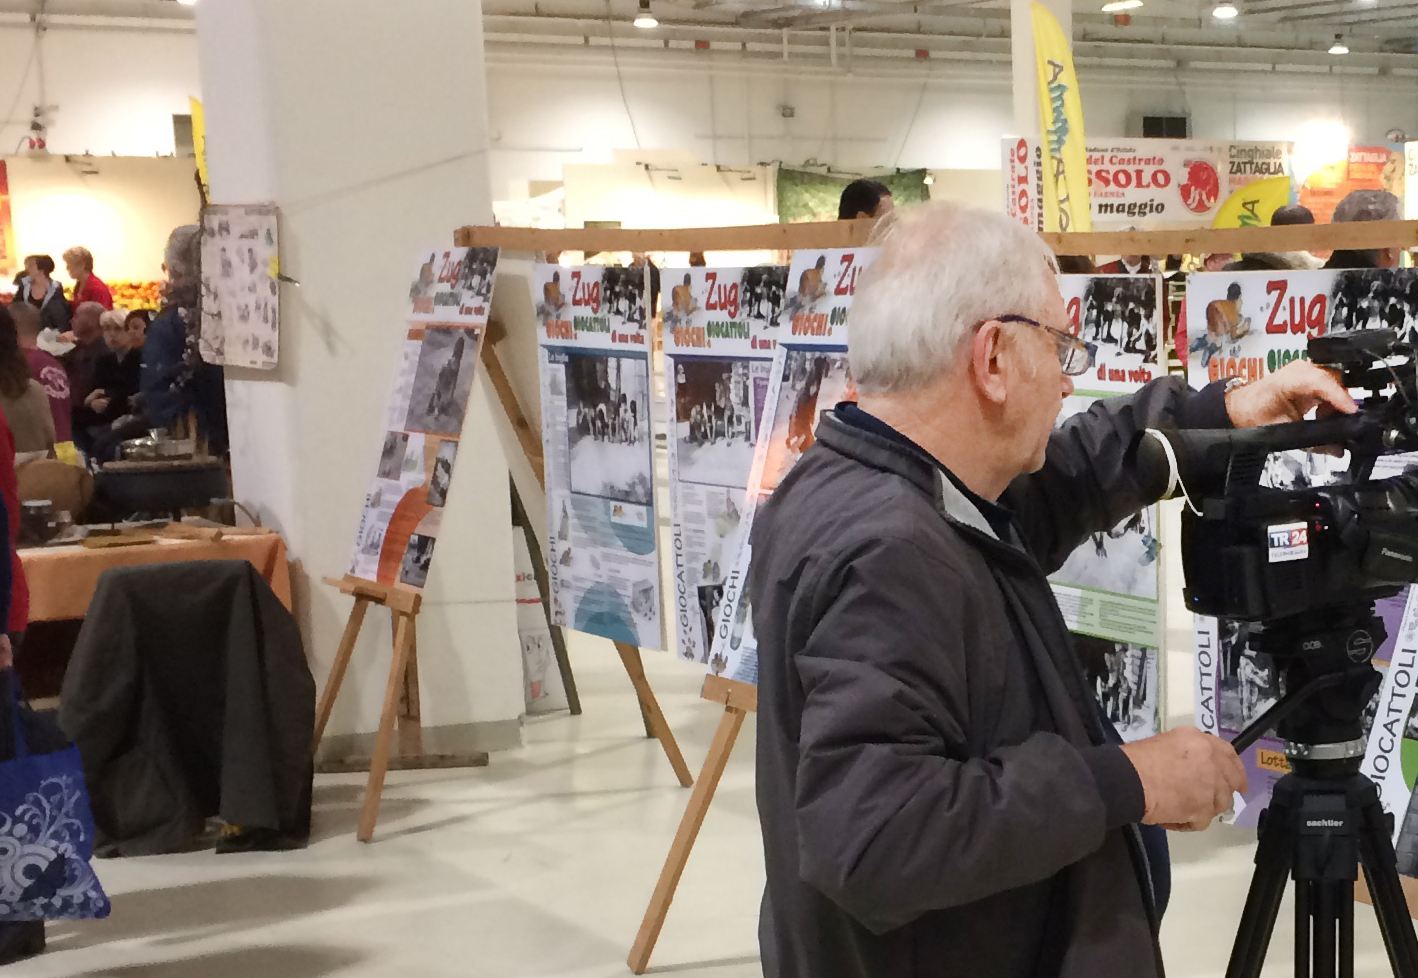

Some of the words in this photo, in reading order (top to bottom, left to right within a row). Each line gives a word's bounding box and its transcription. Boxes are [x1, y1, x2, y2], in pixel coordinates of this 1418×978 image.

[1109, 155, 1164, 166] Castrato
[1229, 160, 1285, 176] ZATTAGLIA
[1098, 198, 1165, 218] maggio
[571, 270, 601, 315] Zug
[705, 271, 740, 319] Zug
[1265, 279, 1327, 341] Zug
[719, 569, 741, 641] GIOCHI
